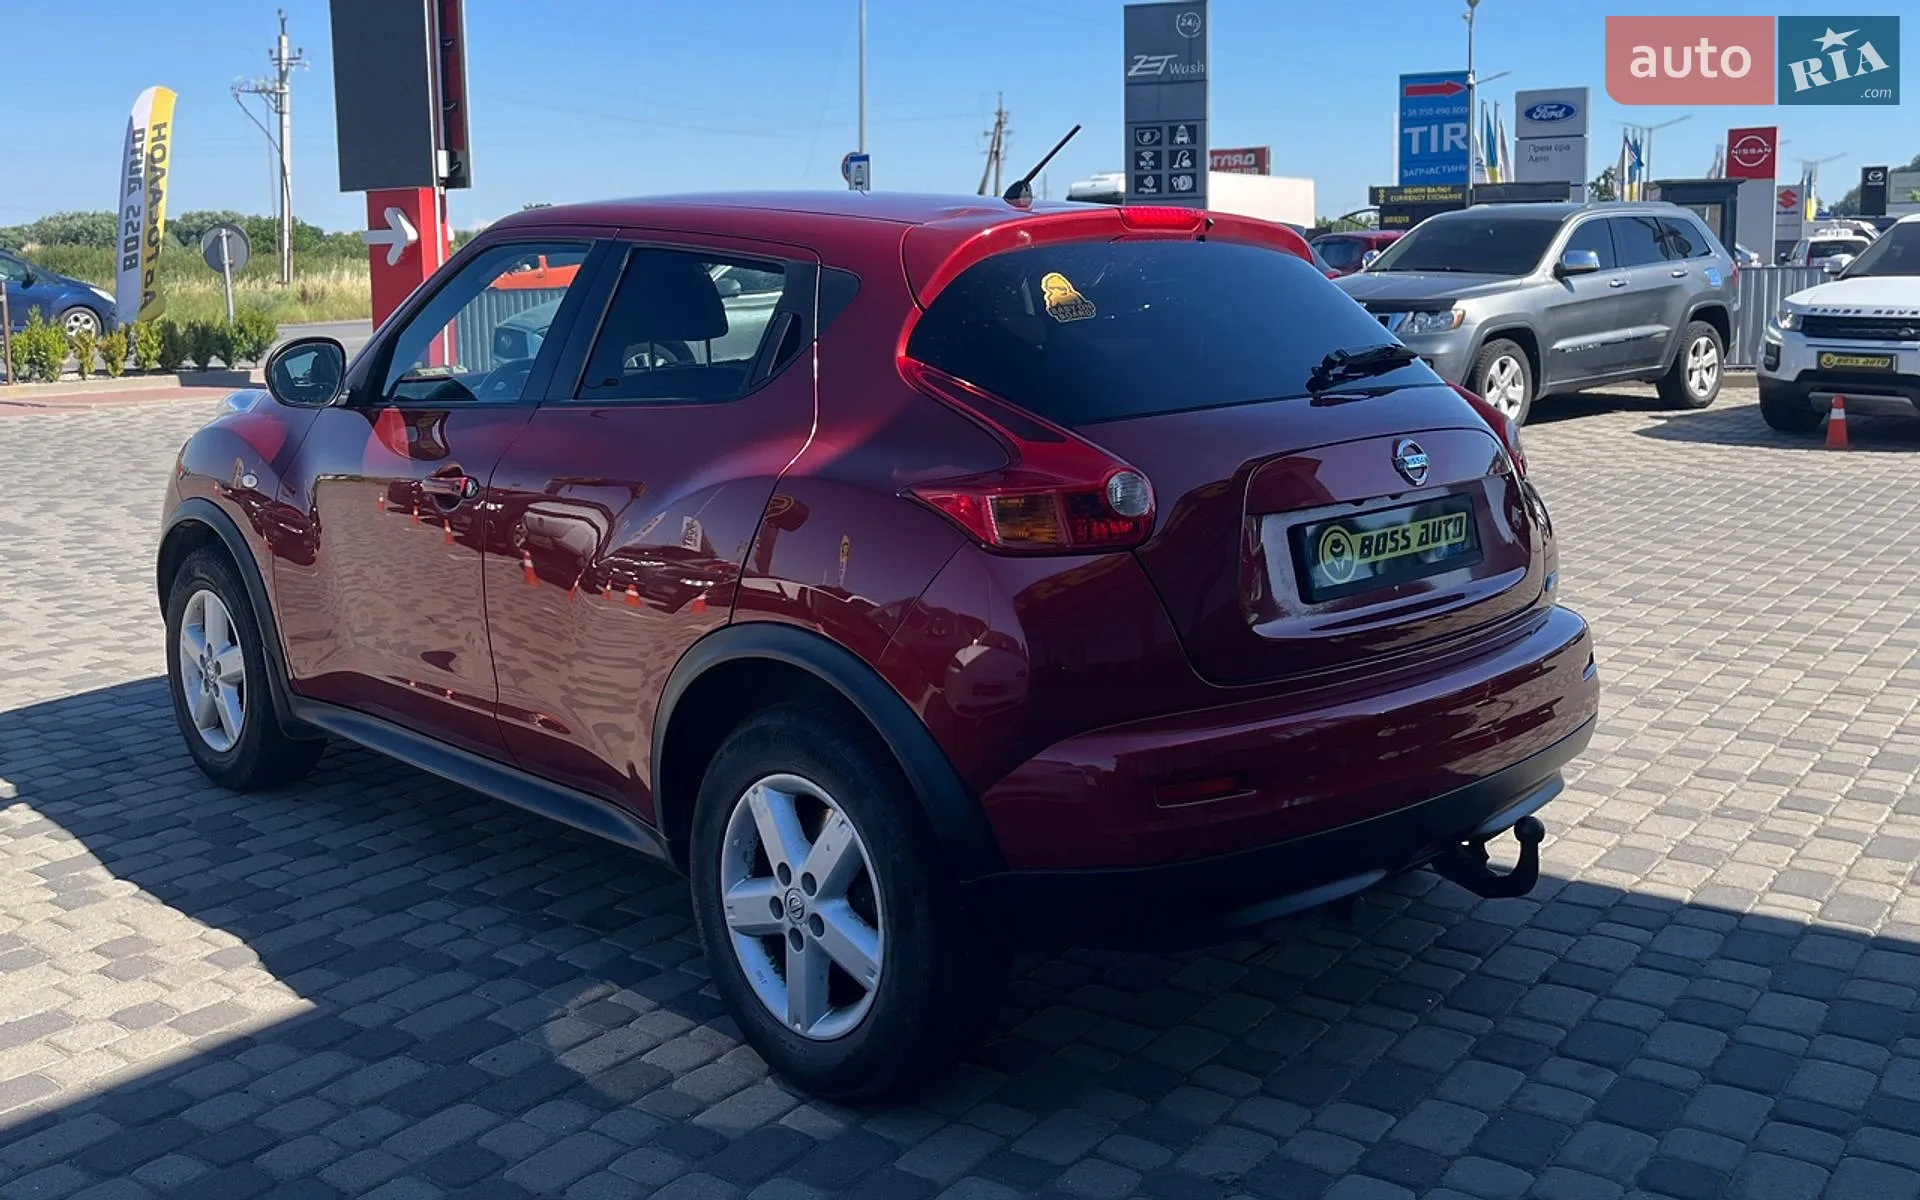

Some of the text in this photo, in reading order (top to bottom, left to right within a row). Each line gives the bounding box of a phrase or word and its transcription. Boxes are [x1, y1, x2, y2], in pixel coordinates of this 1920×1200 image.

[1127, 54, 1179, 76] ZET
[1532, 105, 1567, 119] Ford
[1403, 122, 1467, 154] TIR
[1731, 144, 1772, 156] NISSAN
[1359, 528, 1412, 559] BOSS
[1417, 515, 1464, 547] AUTO
